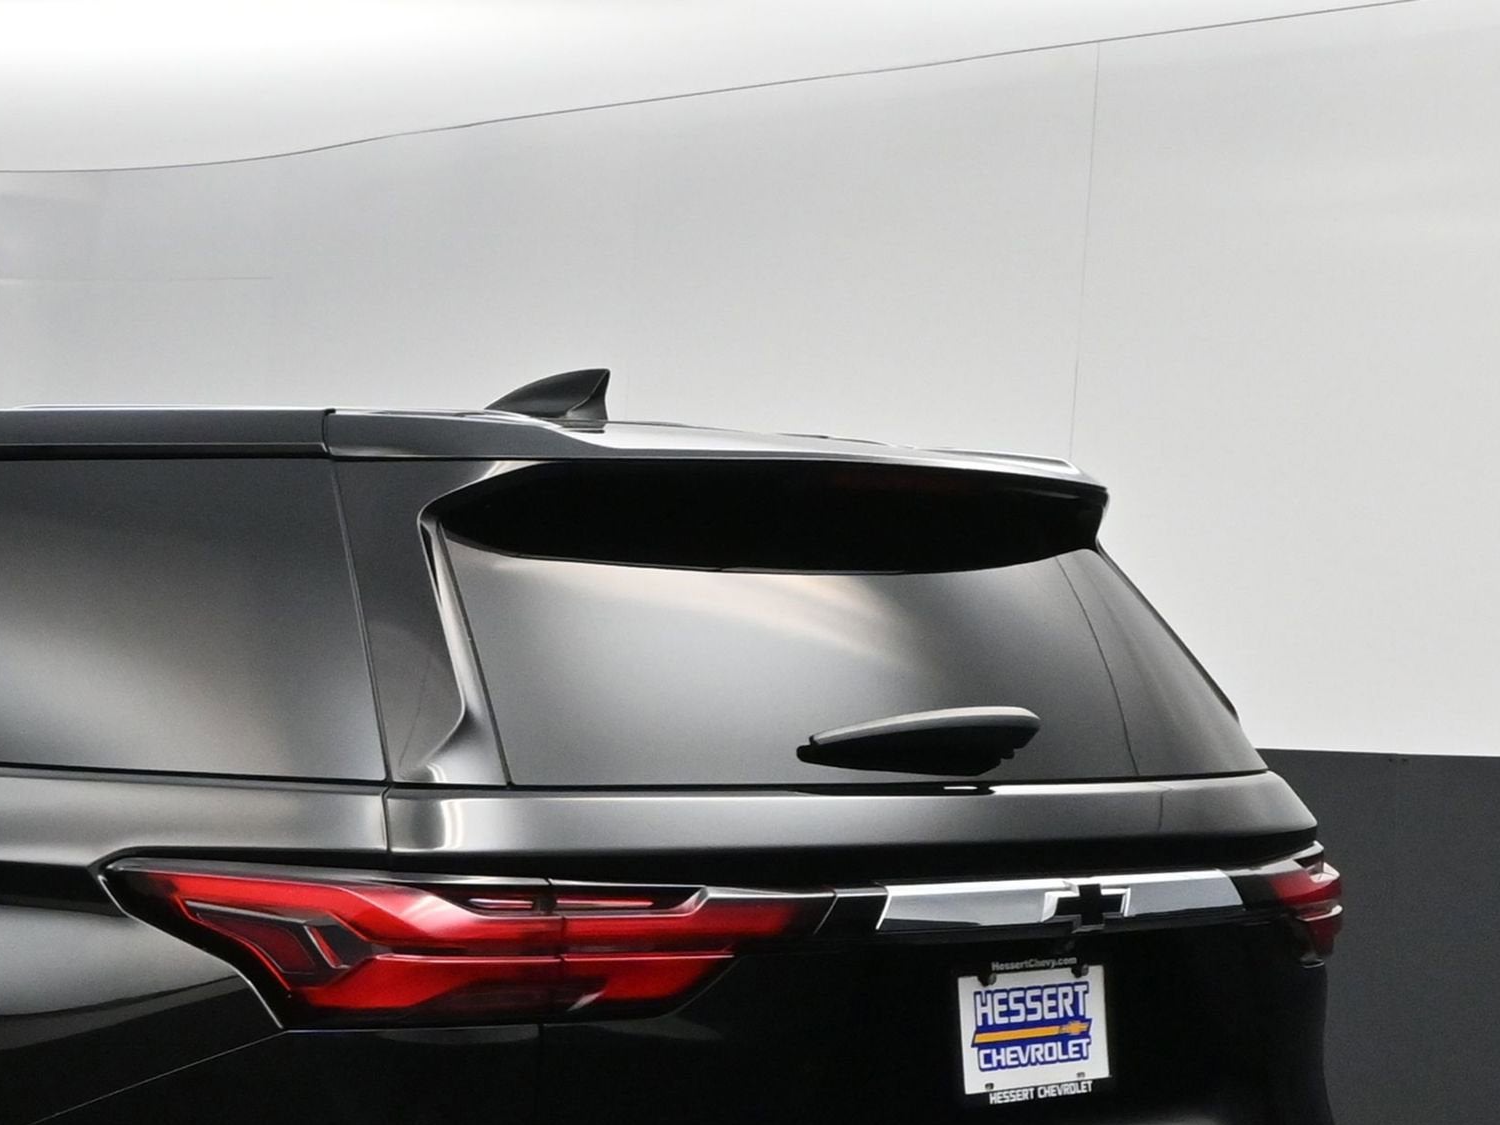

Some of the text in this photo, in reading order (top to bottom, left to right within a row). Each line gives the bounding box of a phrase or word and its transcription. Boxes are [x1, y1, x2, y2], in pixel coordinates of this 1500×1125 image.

[991, 956, 1078, 971] HessertChevy.com
[974, 982, 1089, 1027] HESSERT
[978, 1038, 1091, 1071] CHEVROLET
[989, 1080, 1093, 1105] HESSERT CHEVROLET
